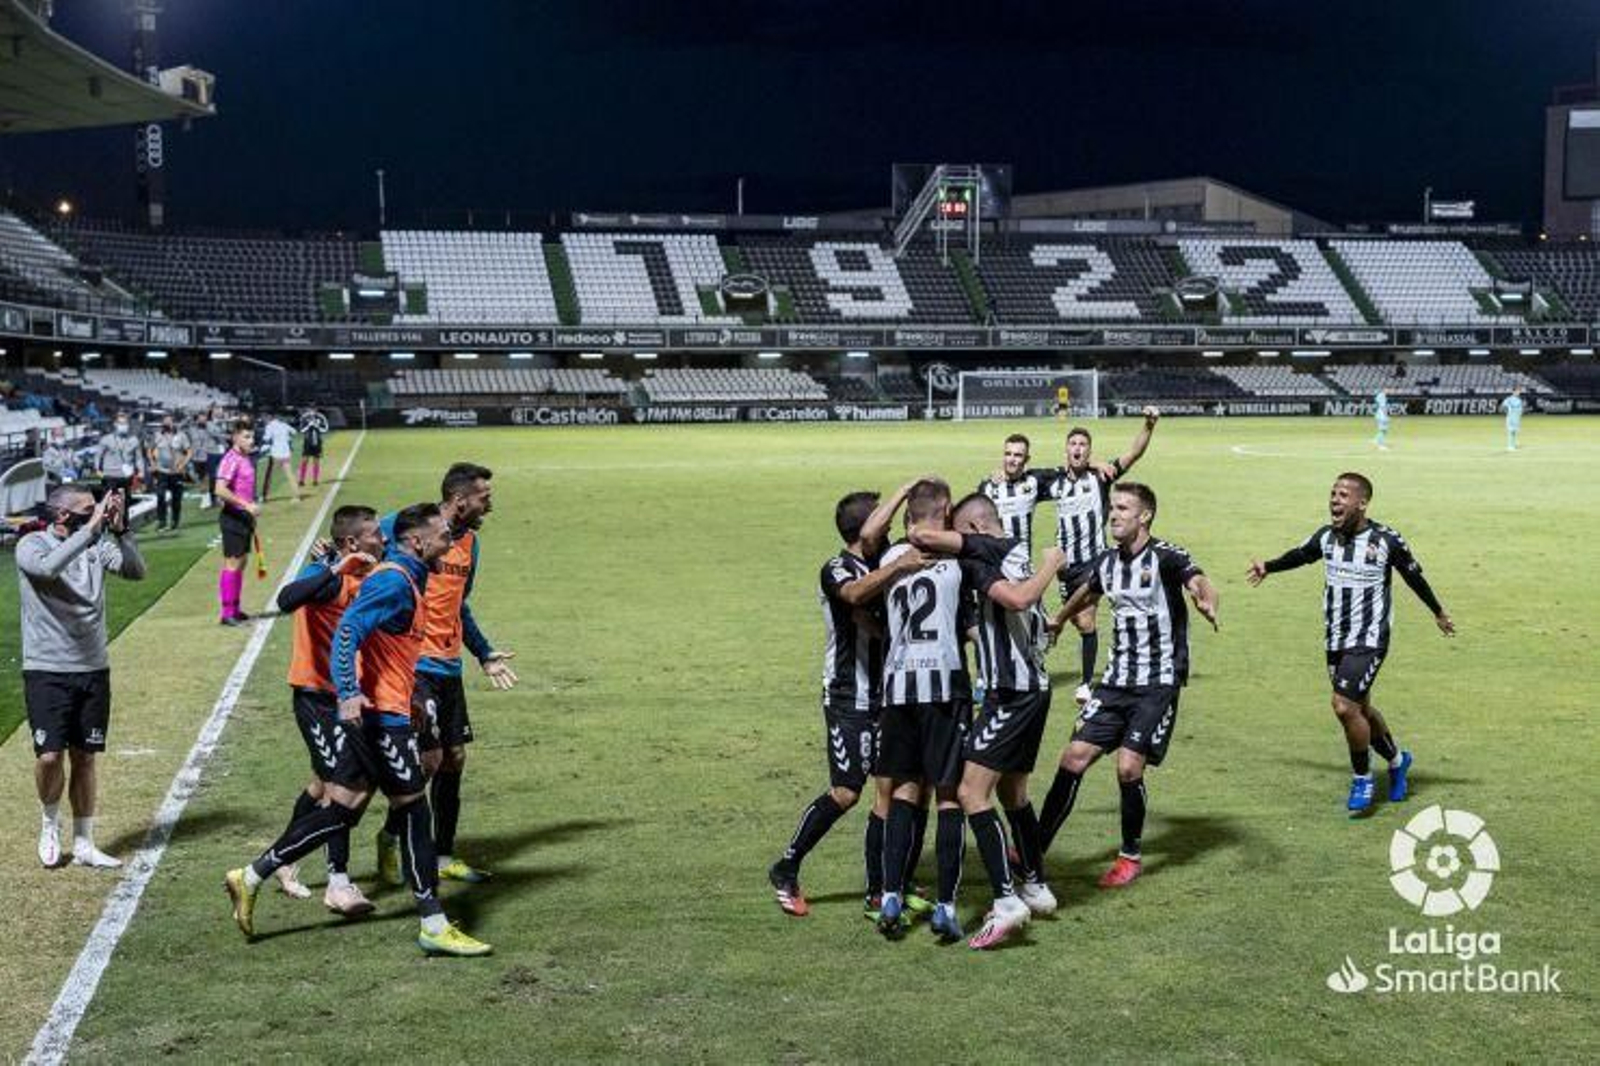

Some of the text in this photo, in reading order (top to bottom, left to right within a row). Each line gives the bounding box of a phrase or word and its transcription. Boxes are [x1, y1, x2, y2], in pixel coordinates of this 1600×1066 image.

[439, 331, 533, 344] LEONAUTO
[853, 405, 908, 420] hummel
[1425, 399, 1498, 414] FOOTTERS
[891, 576, 939, 641] 12
